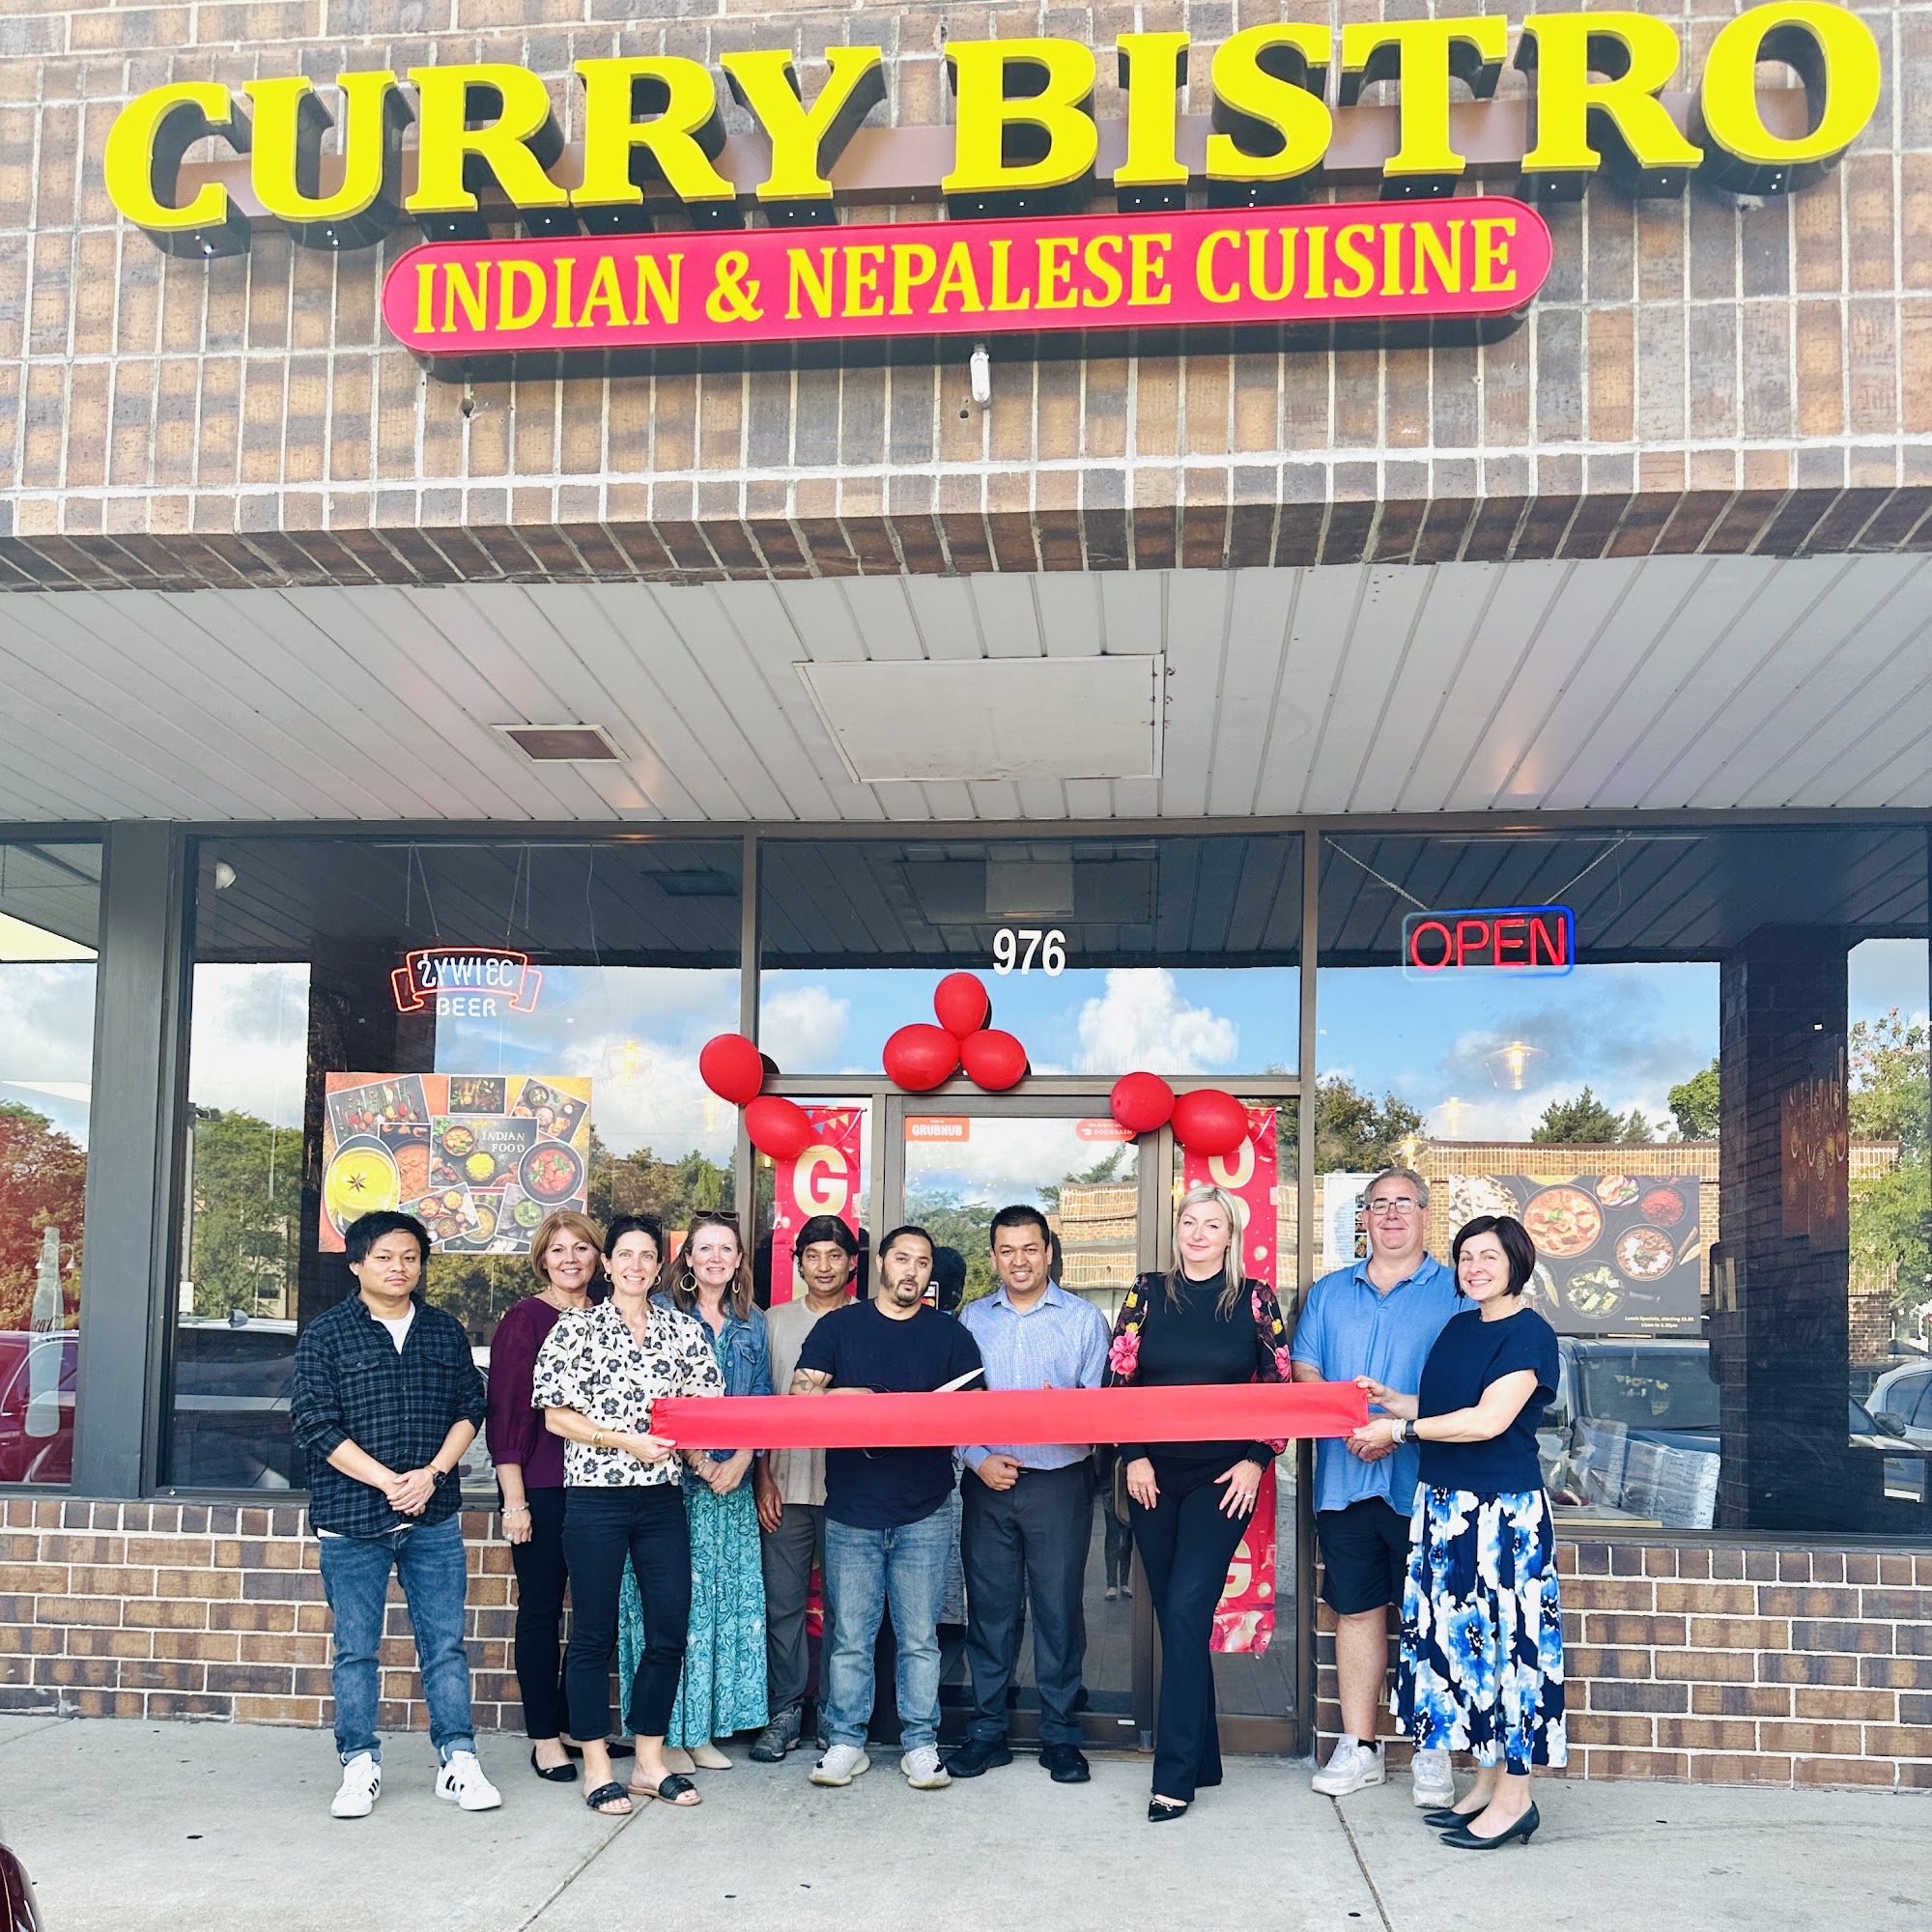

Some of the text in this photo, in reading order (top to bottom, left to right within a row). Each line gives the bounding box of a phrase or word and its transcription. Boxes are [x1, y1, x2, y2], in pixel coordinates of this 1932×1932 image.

[104, 0, 1881, 230] CURRY BISTRO
[413, 217, 1517, 333] INDIAN & NEPALESE CUISINE
[993, 928, 1066, 977] 976
[1410, 917, 1566, 972] OPEN
[436, 997, 497, 1016] BEER
[482, 1131, 526, 1141] INDIAN
[912, 1123, 963, 1136] GRUBHUB
[492, 1143, 526, 1152] FOOD
